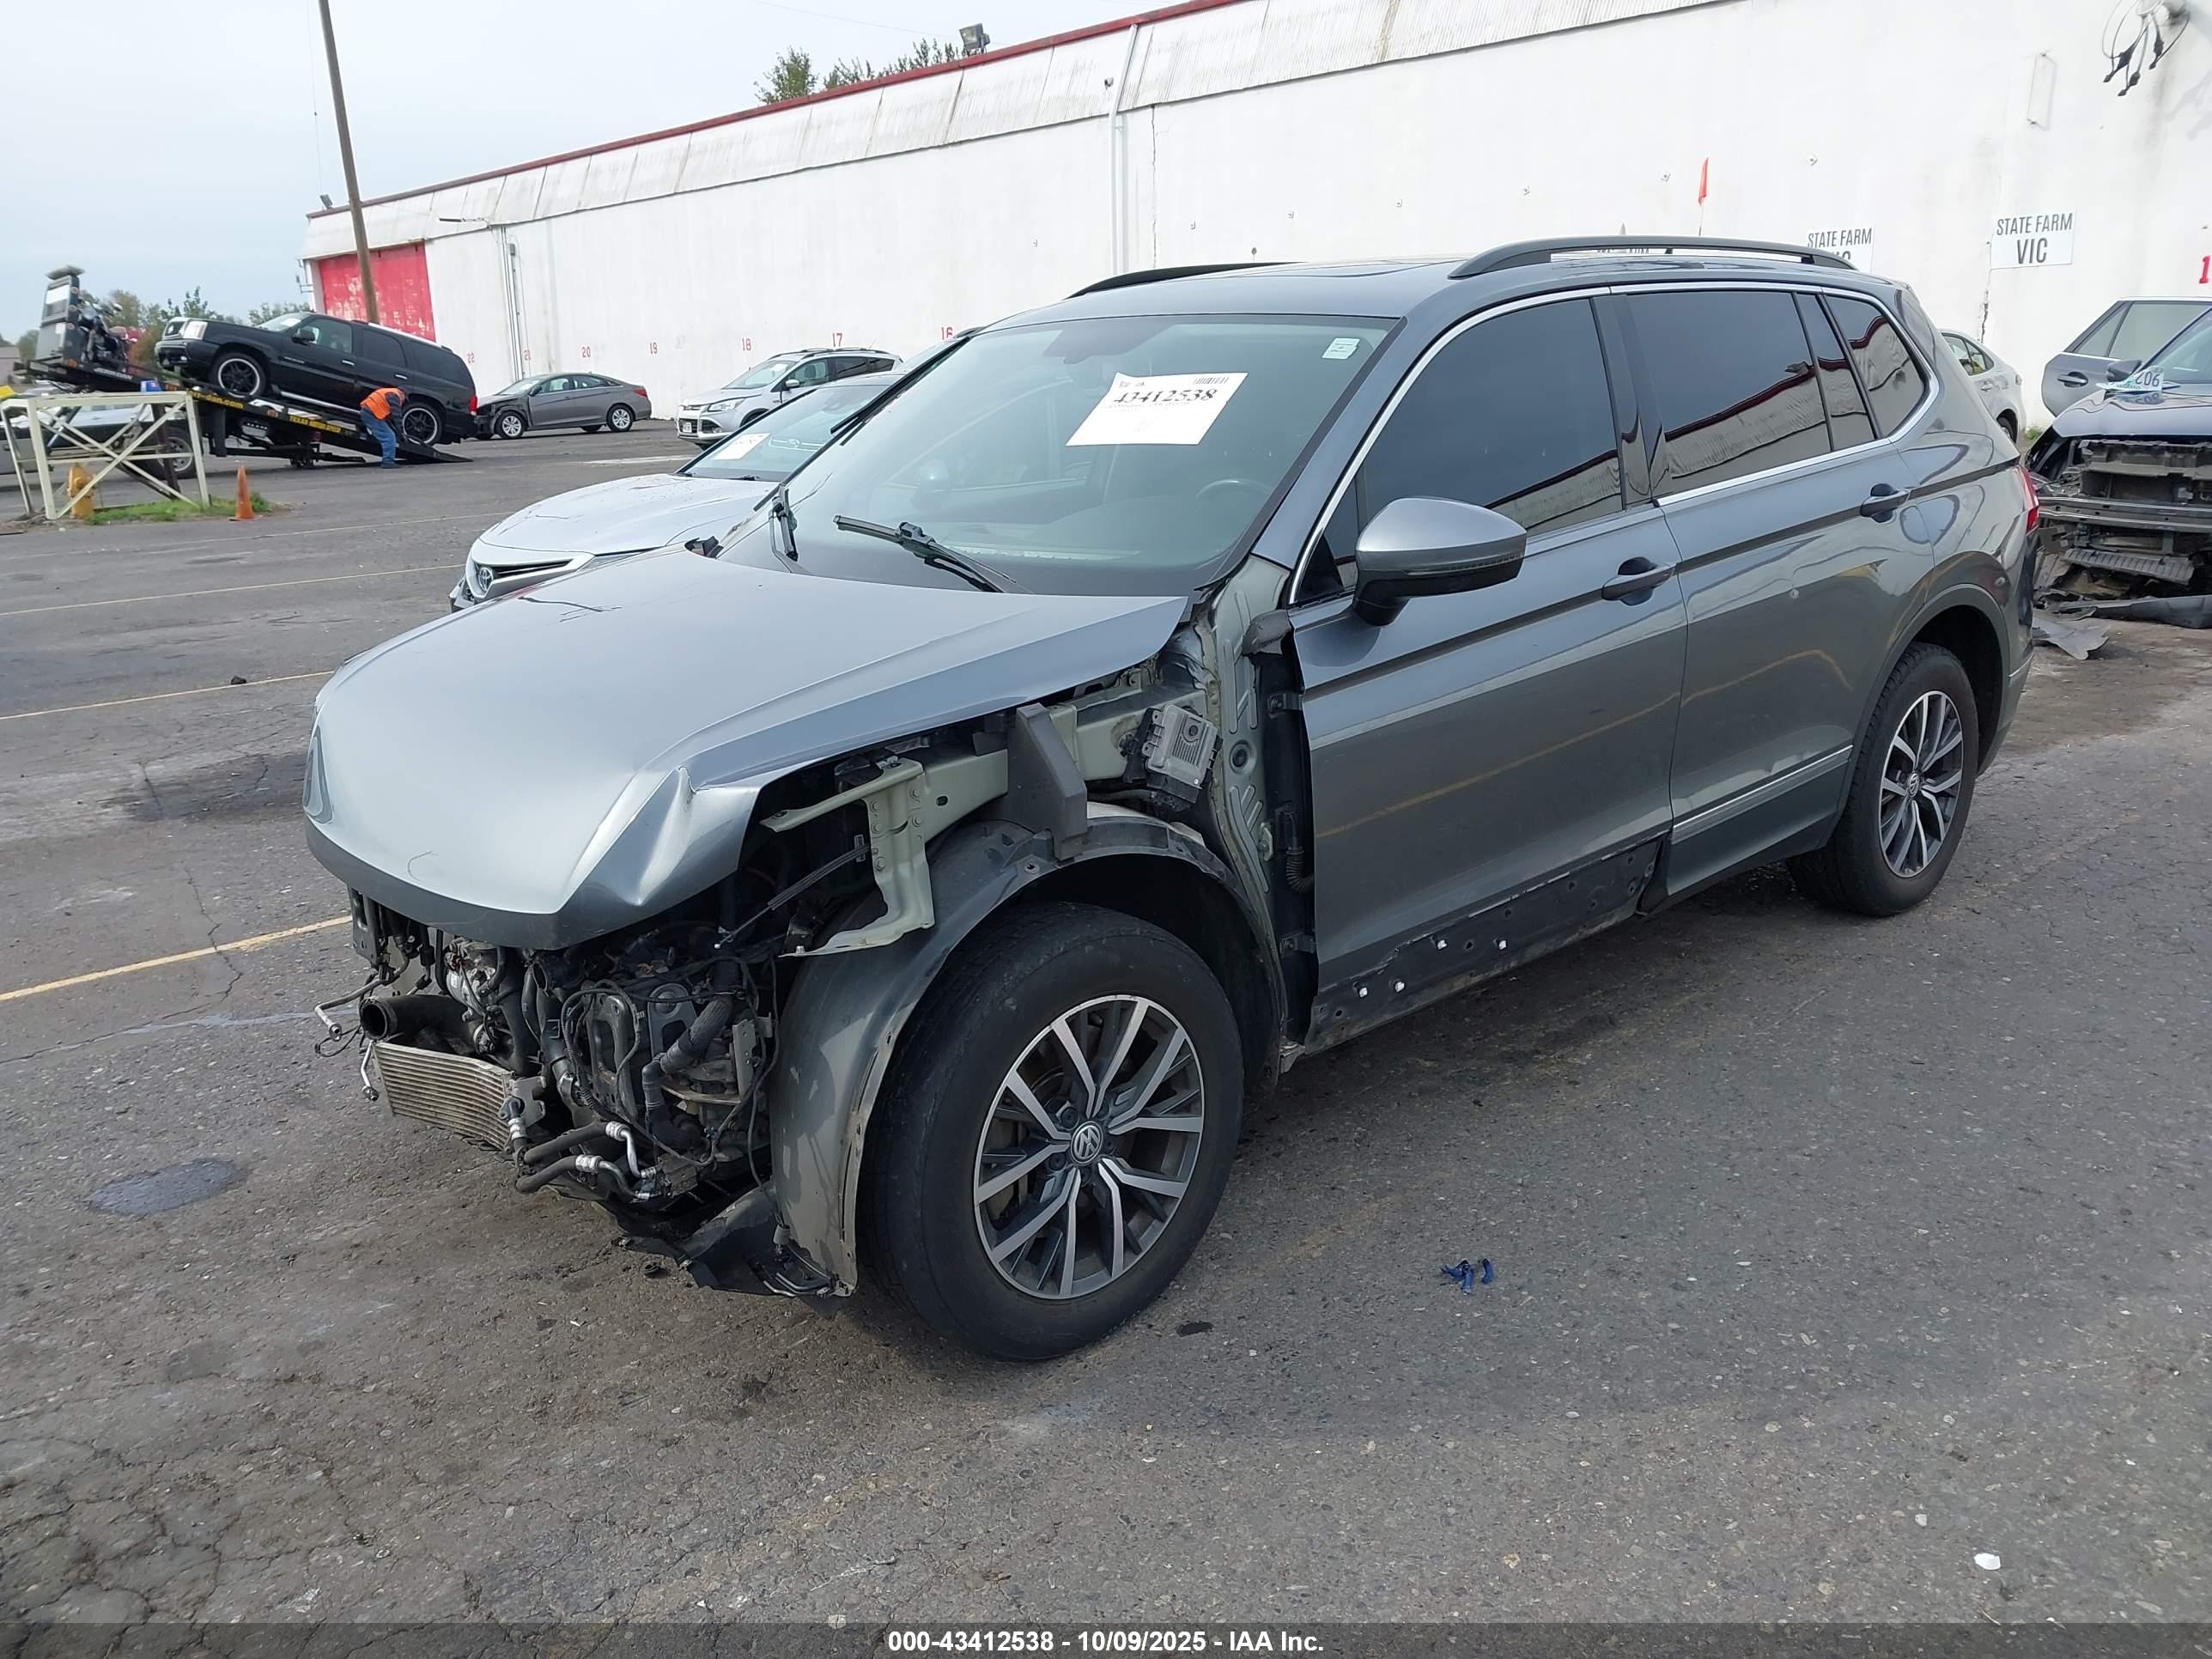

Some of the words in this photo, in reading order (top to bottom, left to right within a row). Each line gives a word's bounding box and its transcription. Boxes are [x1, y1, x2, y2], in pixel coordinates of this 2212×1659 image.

[1996, 216, 2033, 235] STATE
[2035, 213, 2073, 233] FARM
[1808, 230, 1838, 248] STATE
[1840, 228, 1872, 246] FARM
[2016, 238, 2048, 264] VIC
[741, 337, 751, 351] 18
[832, 332, 842, 347] 17
[581, 346, 591, 358] 20
[649, 341, 658, 355] 19
[1113, 388, 1218, 404] 43412538
